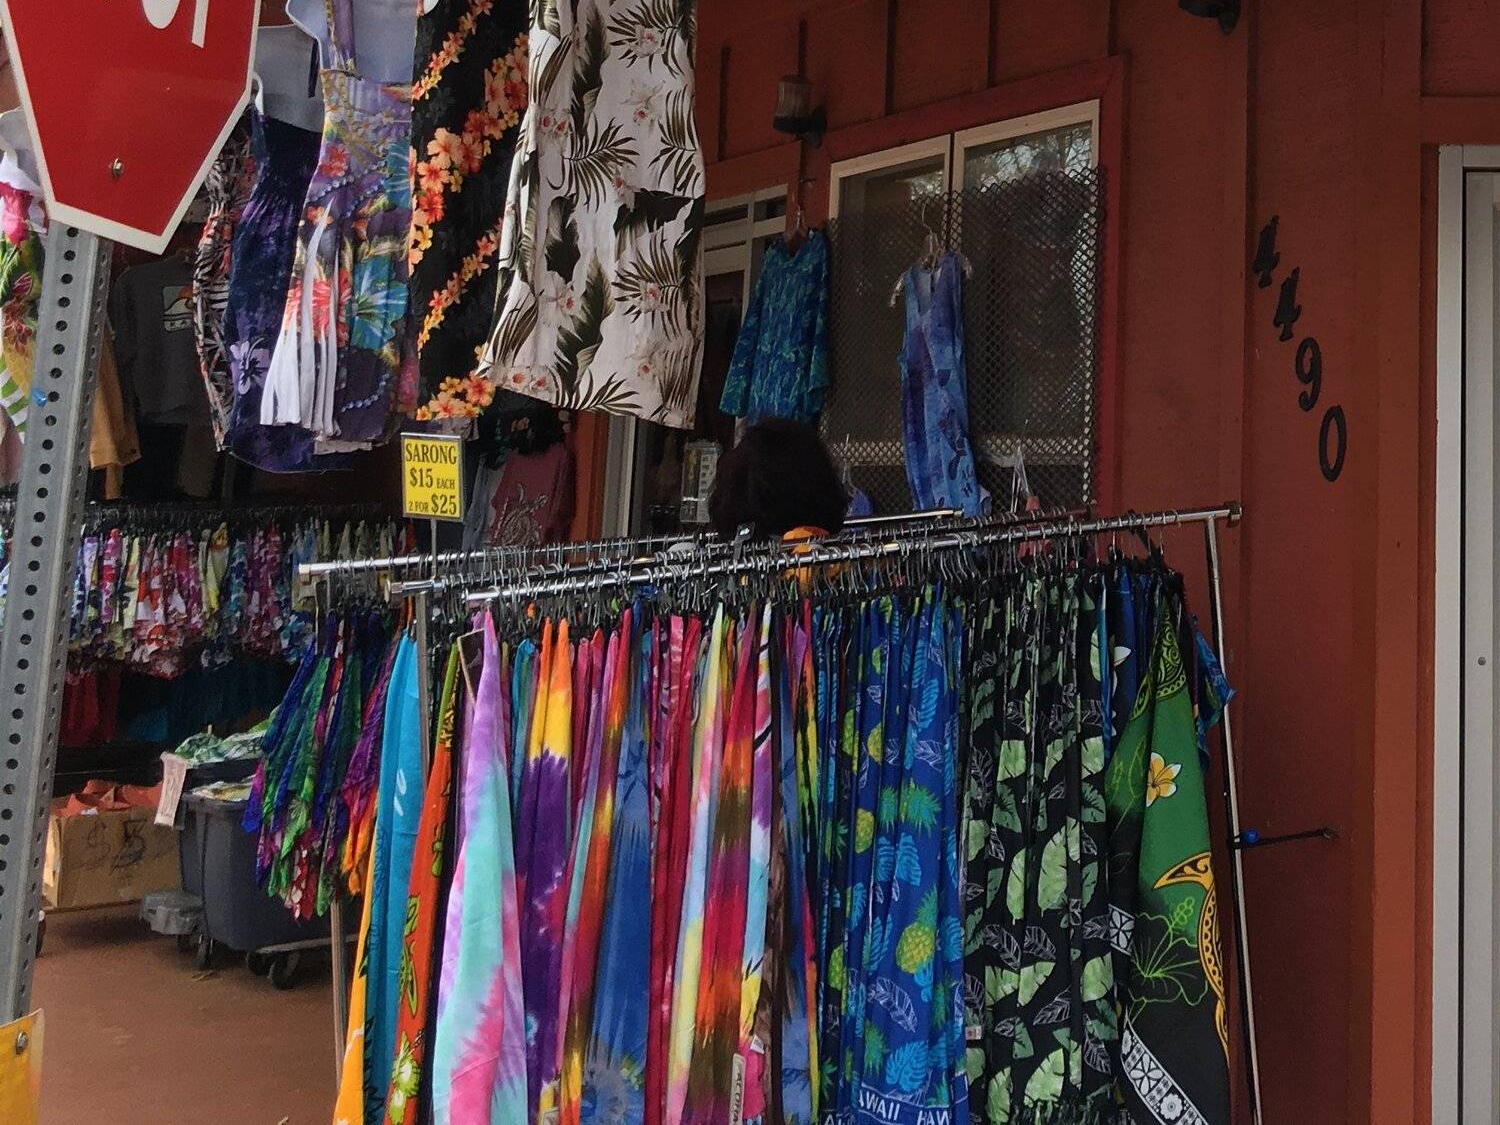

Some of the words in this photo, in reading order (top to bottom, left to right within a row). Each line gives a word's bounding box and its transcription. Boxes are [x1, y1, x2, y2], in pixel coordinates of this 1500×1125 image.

[1251, 214, 1348, 483] 4490
[405, 442, 457, 465] SARONG
[409, 467, 433, 488] $15
[436, 478, 456, 490] EACH
[409, 501, 414, 512] 2
[431, 493, 457, 515] $25
